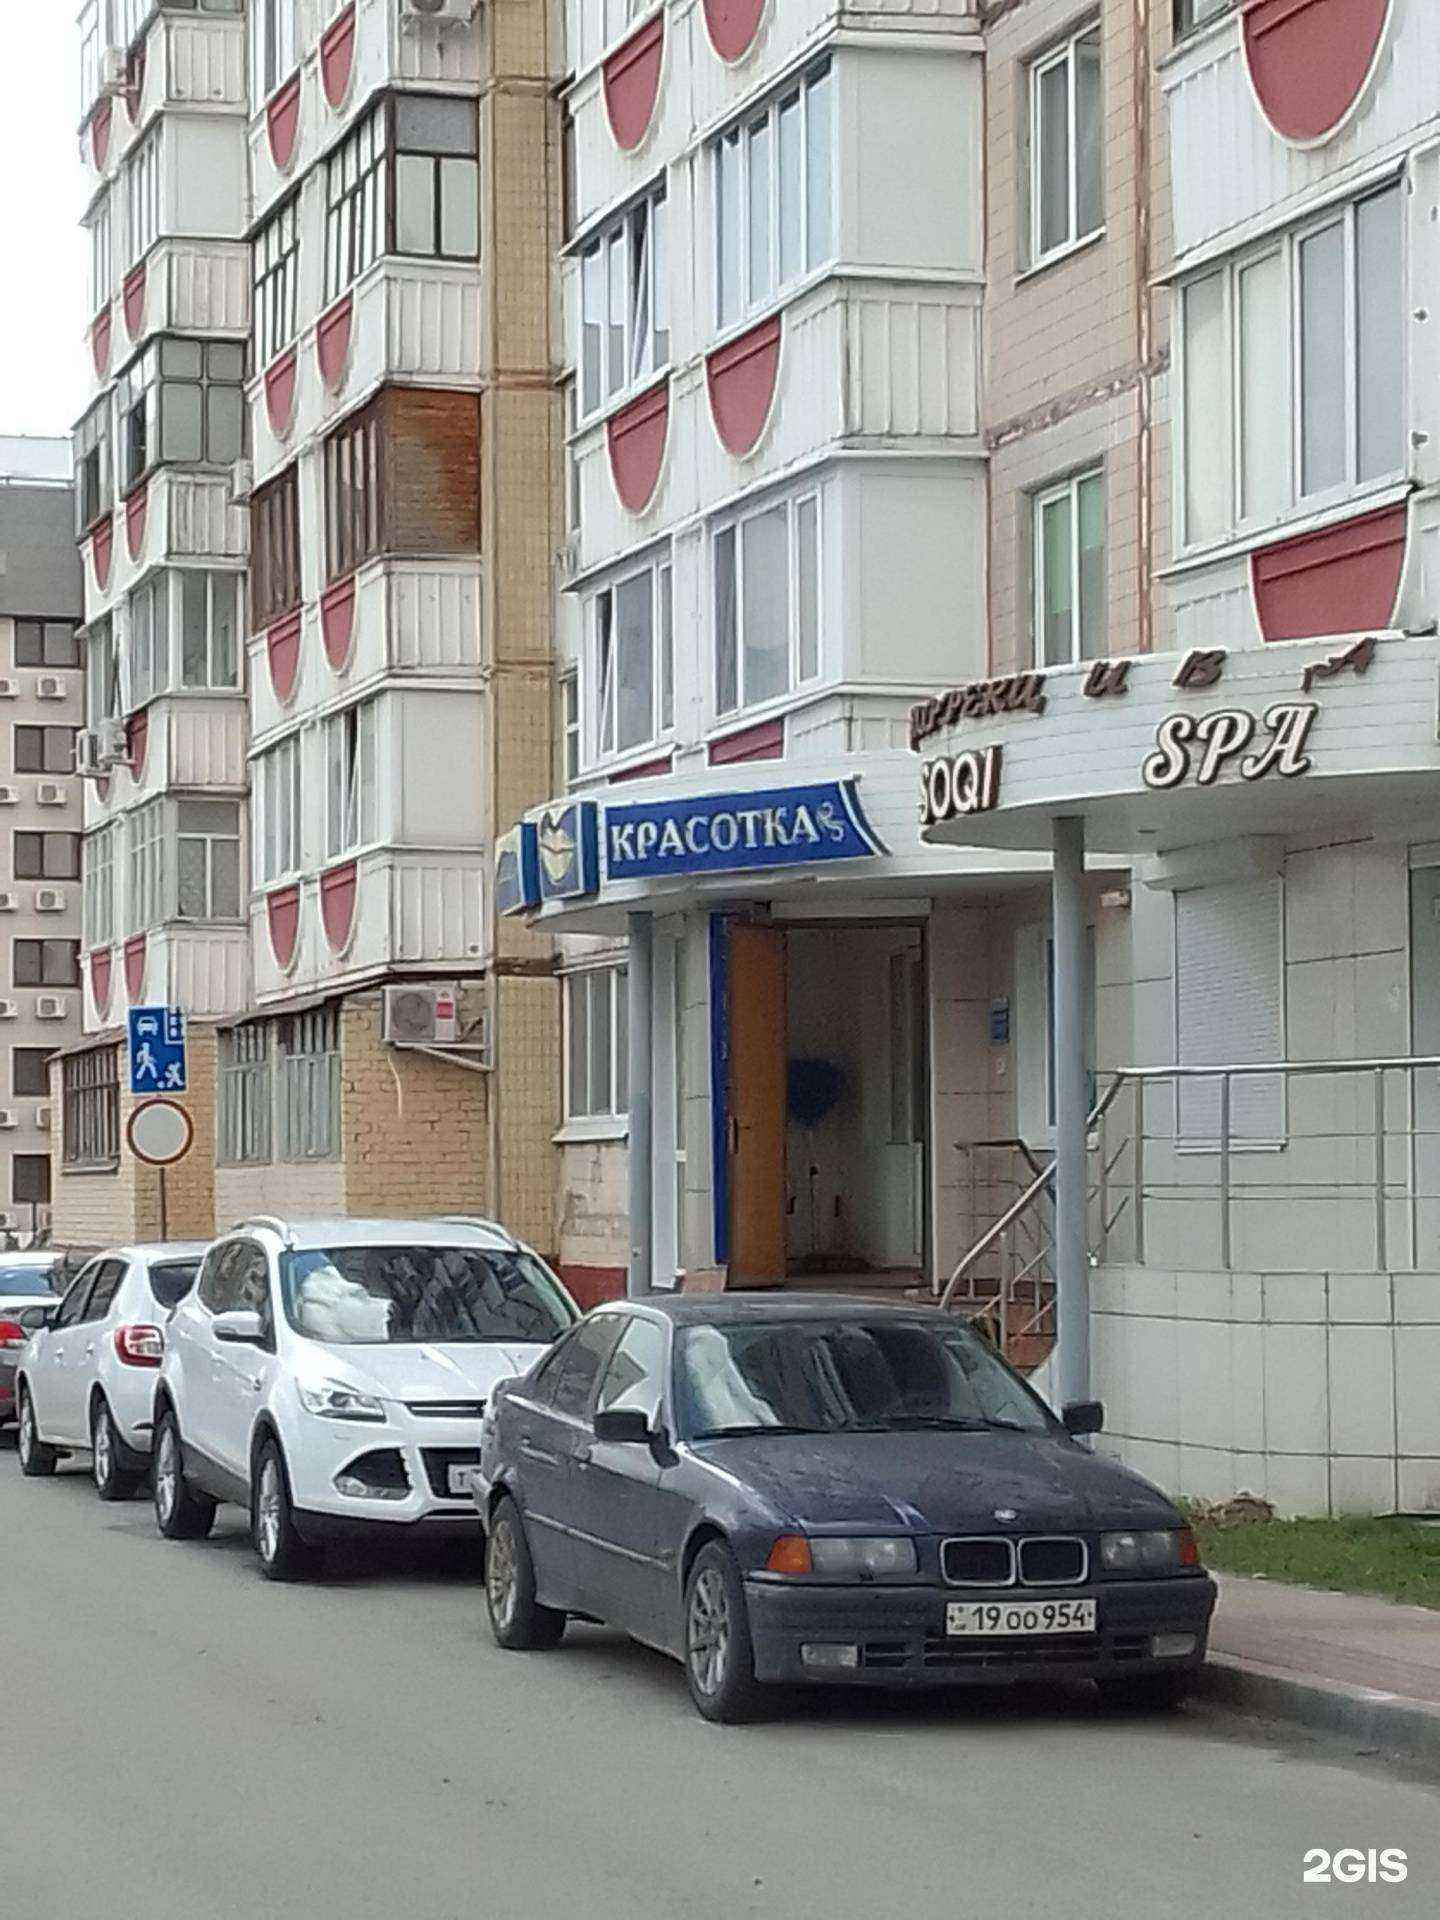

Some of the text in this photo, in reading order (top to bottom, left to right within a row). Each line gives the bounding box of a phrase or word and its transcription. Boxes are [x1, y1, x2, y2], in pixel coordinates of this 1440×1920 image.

[1144, 703, 1317, 788] SPA
[610, 804, 821, 862] КРАСОТКА
[972, 1606, 1001, 1630] 19
[1042, 1603, 1086, 1630] 954
